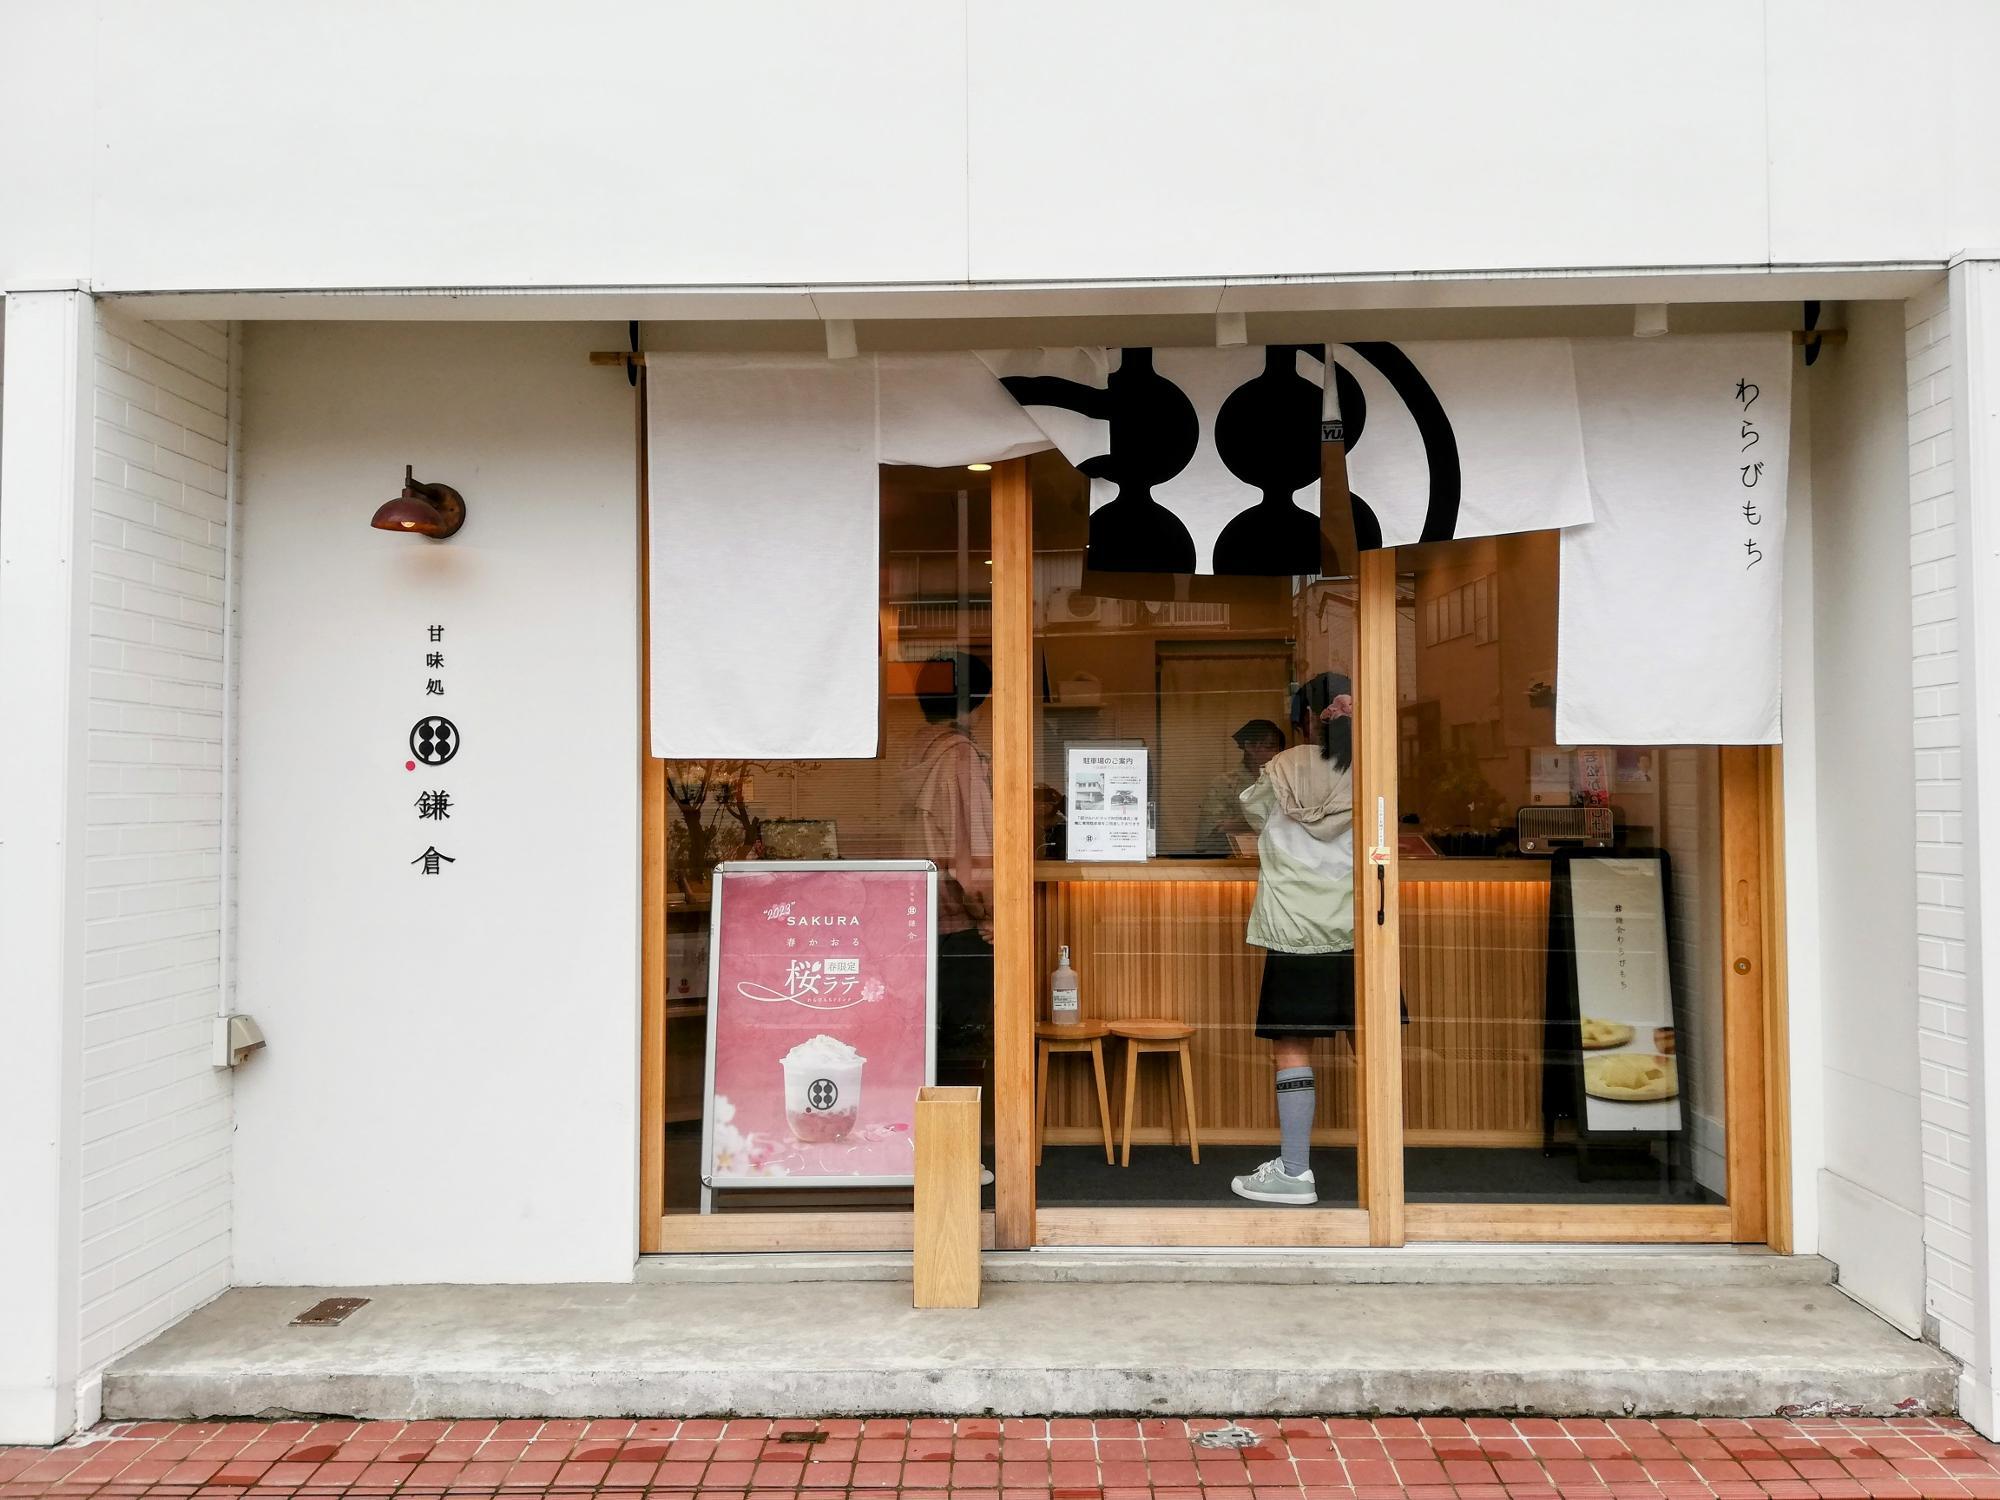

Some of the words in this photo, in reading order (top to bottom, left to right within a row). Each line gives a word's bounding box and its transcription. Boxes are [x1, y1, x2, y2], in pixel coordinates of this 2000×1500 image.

[1735, 377, 1764, 571] わらびもち
[425, 624, 445, 696] 甘味処
[410, 789, 457, 876] 鎌倉
[786, 916, 860, 926] SAKURA
[786, 937, 860, 948] 春かおる
